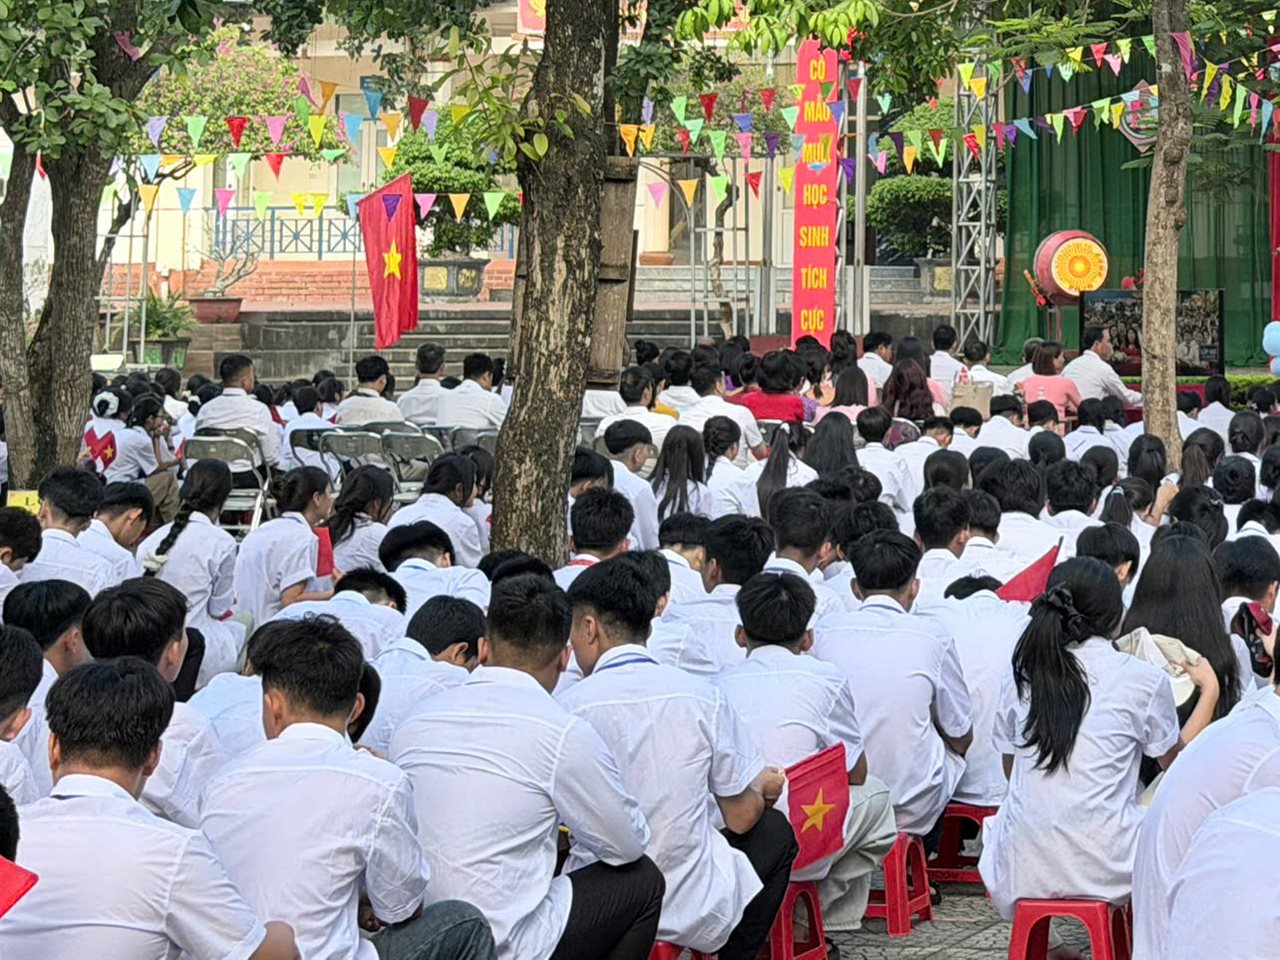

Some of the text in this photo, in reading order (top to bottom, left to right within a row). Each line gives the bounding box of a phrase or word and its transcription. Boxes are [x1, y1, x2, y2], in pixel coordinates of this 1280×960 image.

[803, 183, 828, 209] HỌC
[799, 225, 829, 248] SINH
[801, 264, 828, 289] TÍCH
[800, 304, 825, 336] CỰC
